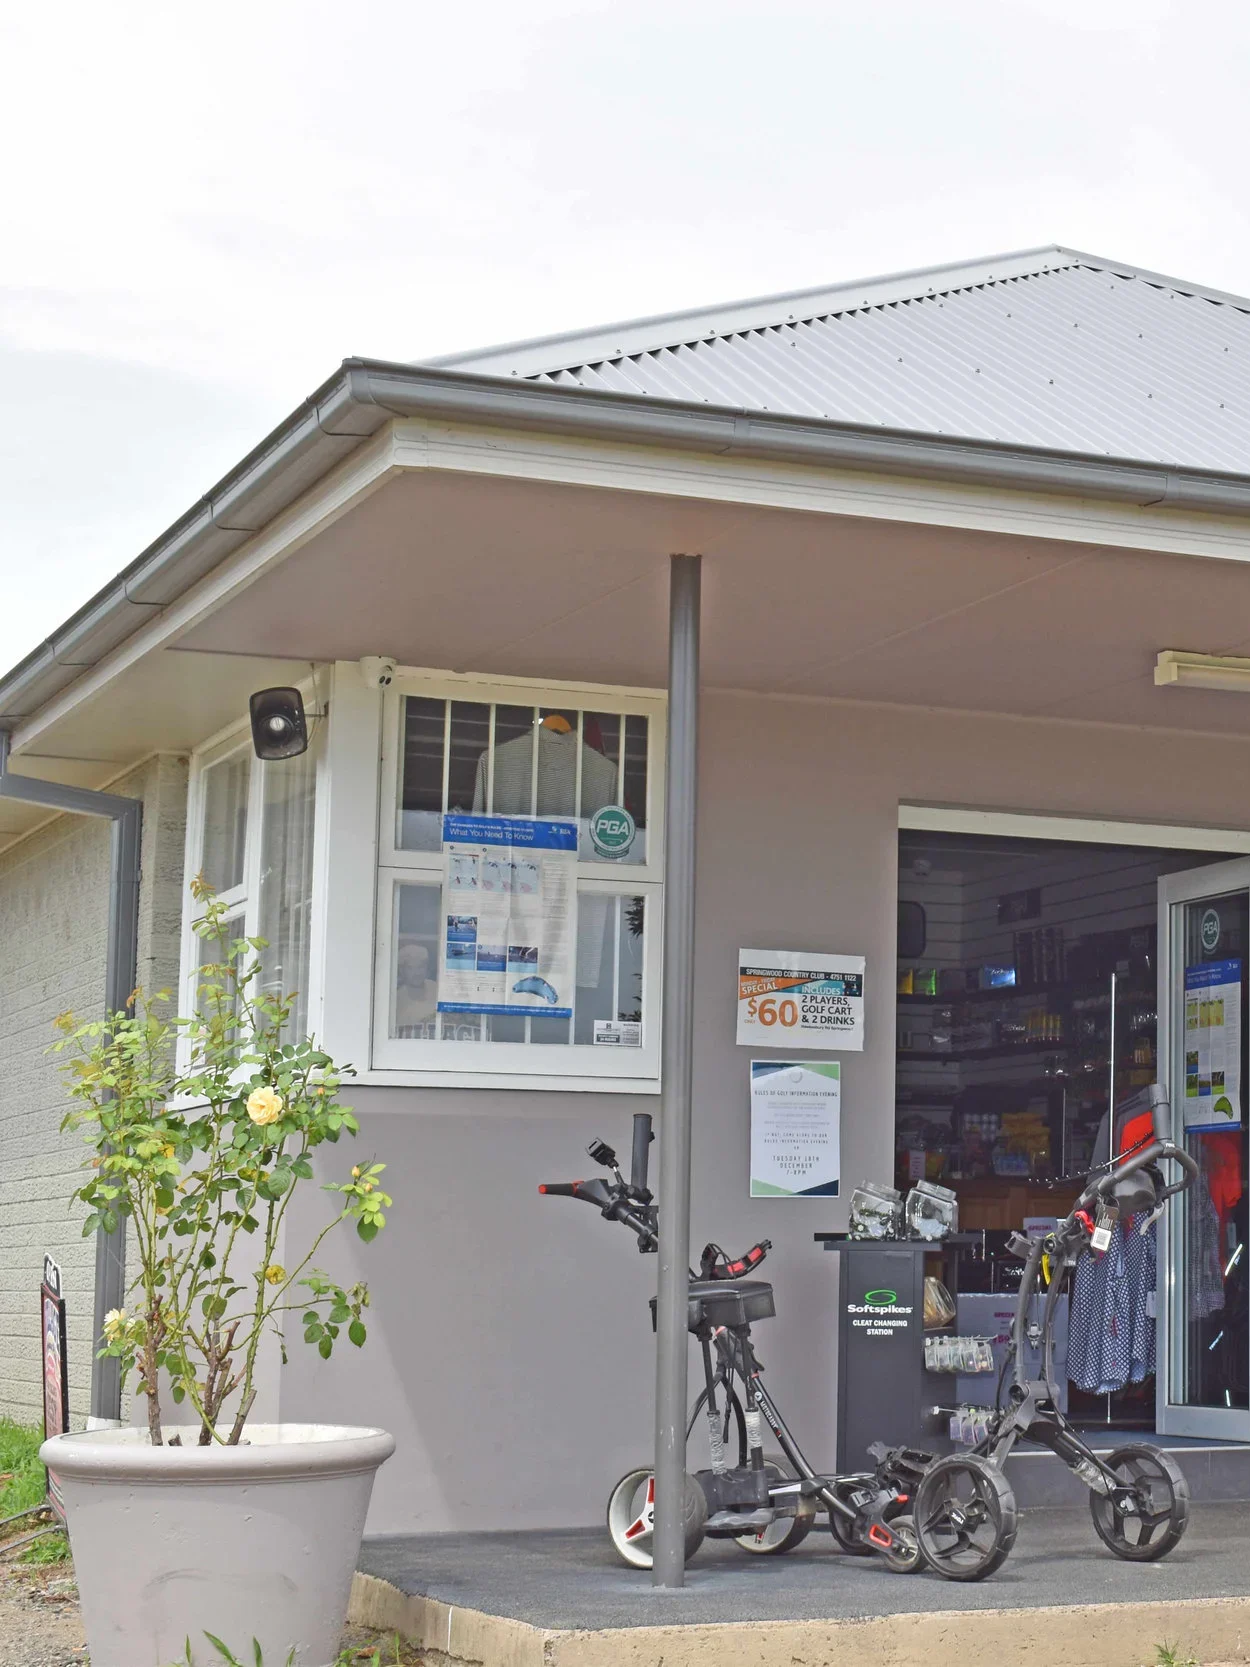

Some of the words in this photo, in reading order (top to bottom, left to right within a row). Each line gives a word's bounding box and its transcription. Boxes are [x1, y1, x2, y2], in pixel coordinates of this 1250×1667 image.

[596, 819, 629, 836] PGA
[449, 828, 468, 836] What
[469, 829, 484, 838] You
[484, 831, 503, 839] Need
[504, 831, 513, 840] To
[514, 833, 534, 841] Know
[1203, 921, 1218, 934] PGA
[745, 968, 783, 977] SPRINGWOOD
[783, 971, 809, 979] COUNTRY
[810, 972, 825, 980] CLUB
[742, 982, 778, 995] SPECIAL
[801, 985, 841, 996] INCLUDES
[801, 995, 808, 1003] 2
[810, 995, 850, 1007] PLAYERS,
[747, 997, 798, 1027] $60
[801, 1004, 826, 1014] GOLF
[827, 1006, 852, 1015] CART
[801, 1014, 809, 1023] &
[812, 1015, 818, 1023] 2
[820, 1015, 855, 1025] DRINKS
[847, 1304, 913, 1316] Softspikes
[852, 1319, 873, 1327] CLEAT
[873, 1319, 908, 1327] CHANGING
[866, 1328, 894, 1336] STATION
[760, 1400, 779, 1429] MOTOCADDY
